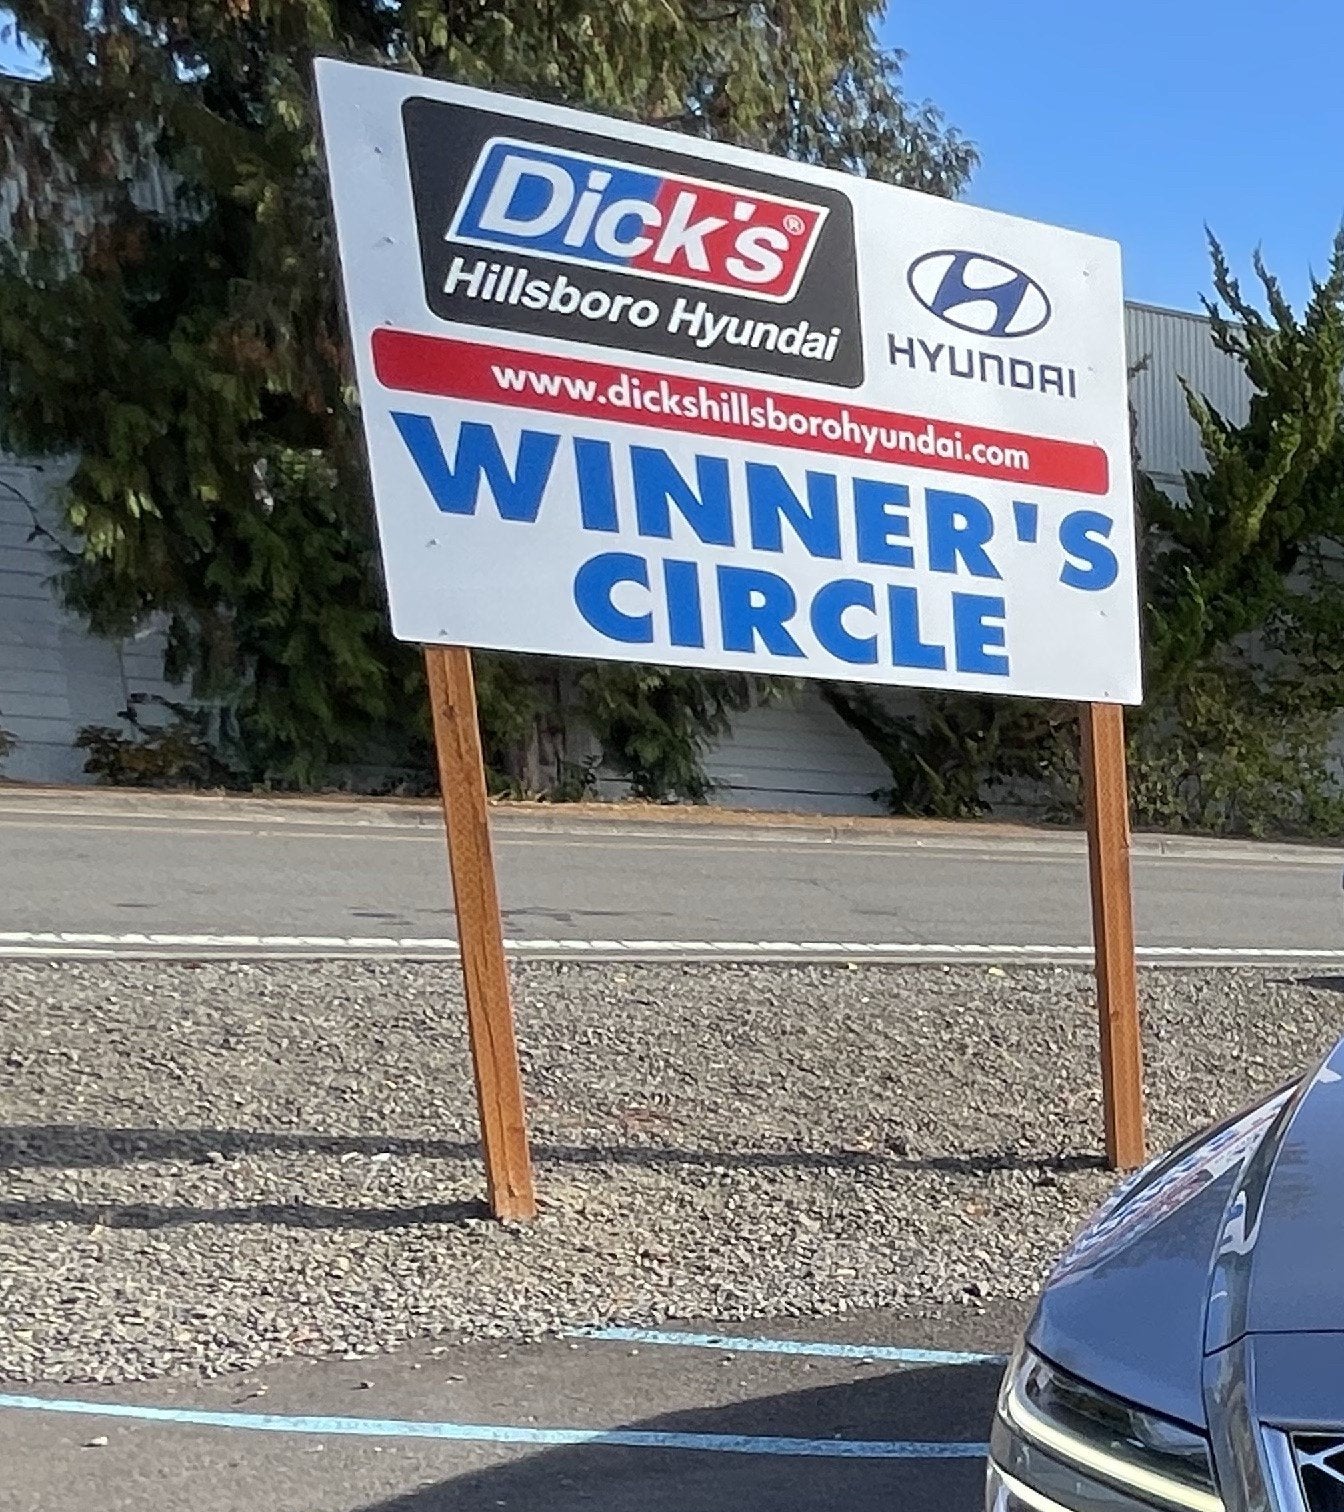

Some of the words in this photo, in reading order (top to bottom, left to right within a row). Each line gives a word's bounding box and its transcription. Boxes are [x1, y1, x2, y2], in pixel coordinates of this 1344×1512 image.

[477, 153, 791, 285] Dick's
[443, 256, 660, 328] Hillsboro
[667, 297, 842, 362] Hyundai
[887, 333, 1077, 399] HYUNDAI
[490, 361, 1031, 472] www.dickshillsborohyundai.com
[389, 410, 1120, 592] WINNER'S
[571, 551, 1011, 678] CIRCLE
